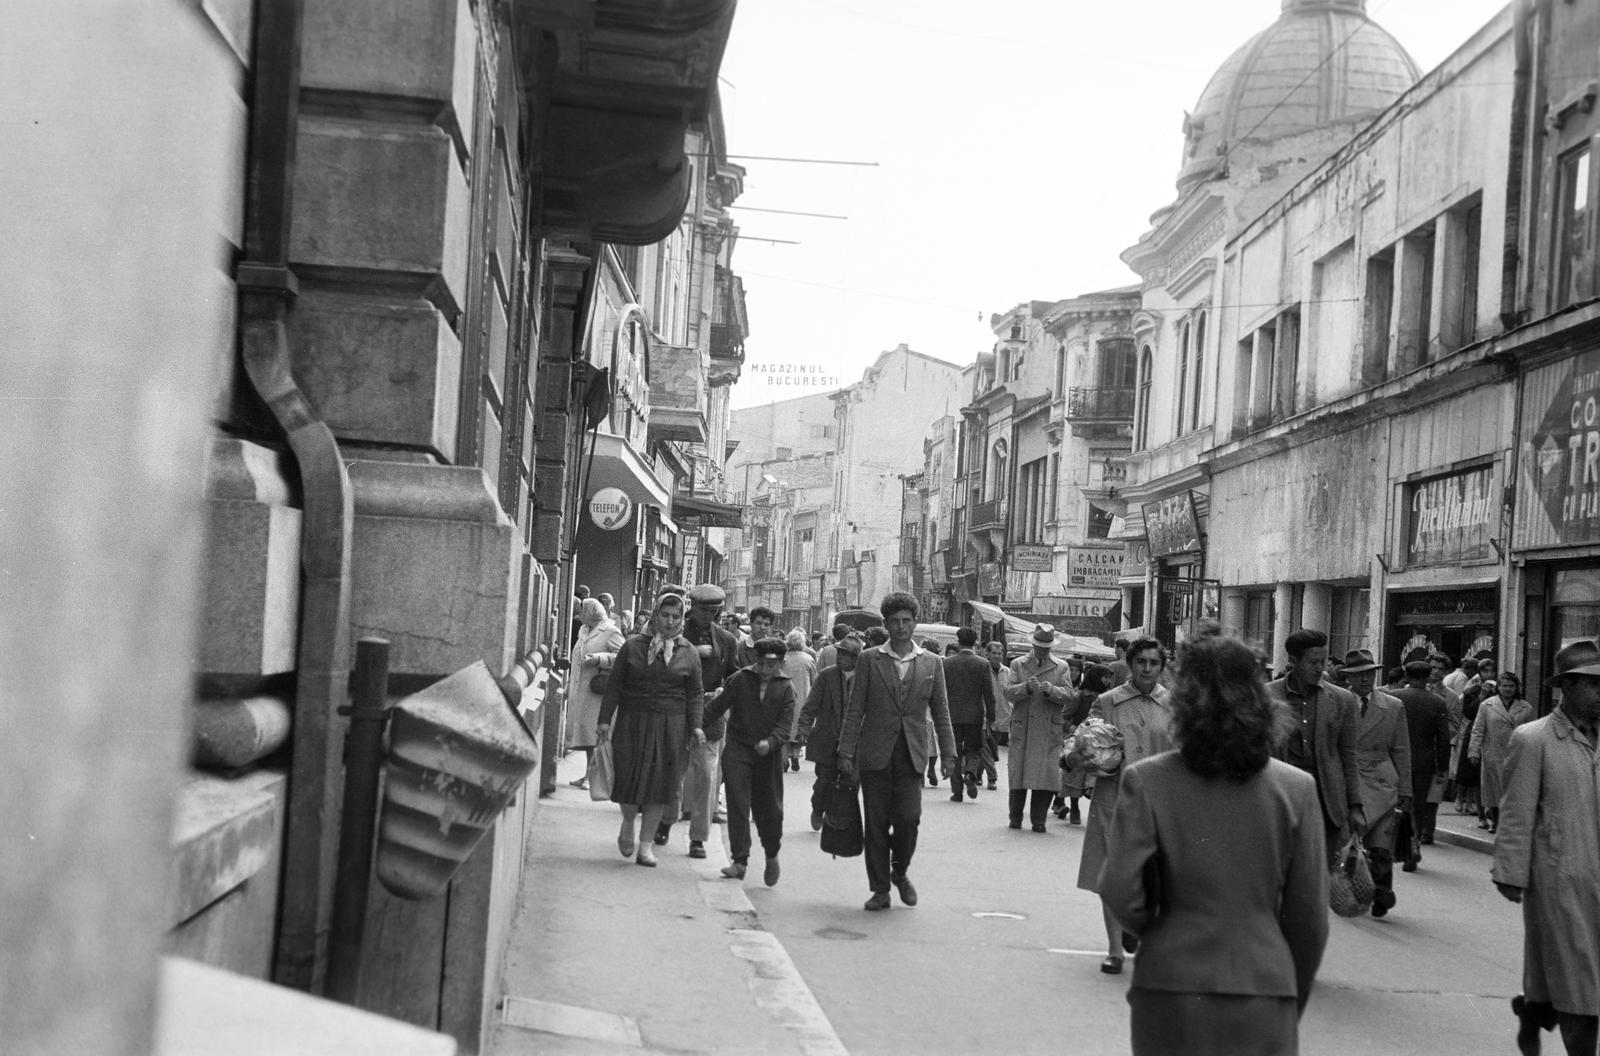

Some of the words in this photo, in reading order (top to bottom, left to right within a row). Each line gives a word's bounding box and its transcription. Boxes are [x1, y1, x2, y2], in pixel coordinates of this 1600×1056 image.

[751, 363, 824, 373] MAGAZINUL
[767, 376, 838, 385] BUCURESTI
[592, 503, 620, 514] TELEFON
[1580, 491, 1600, 519] PLA
